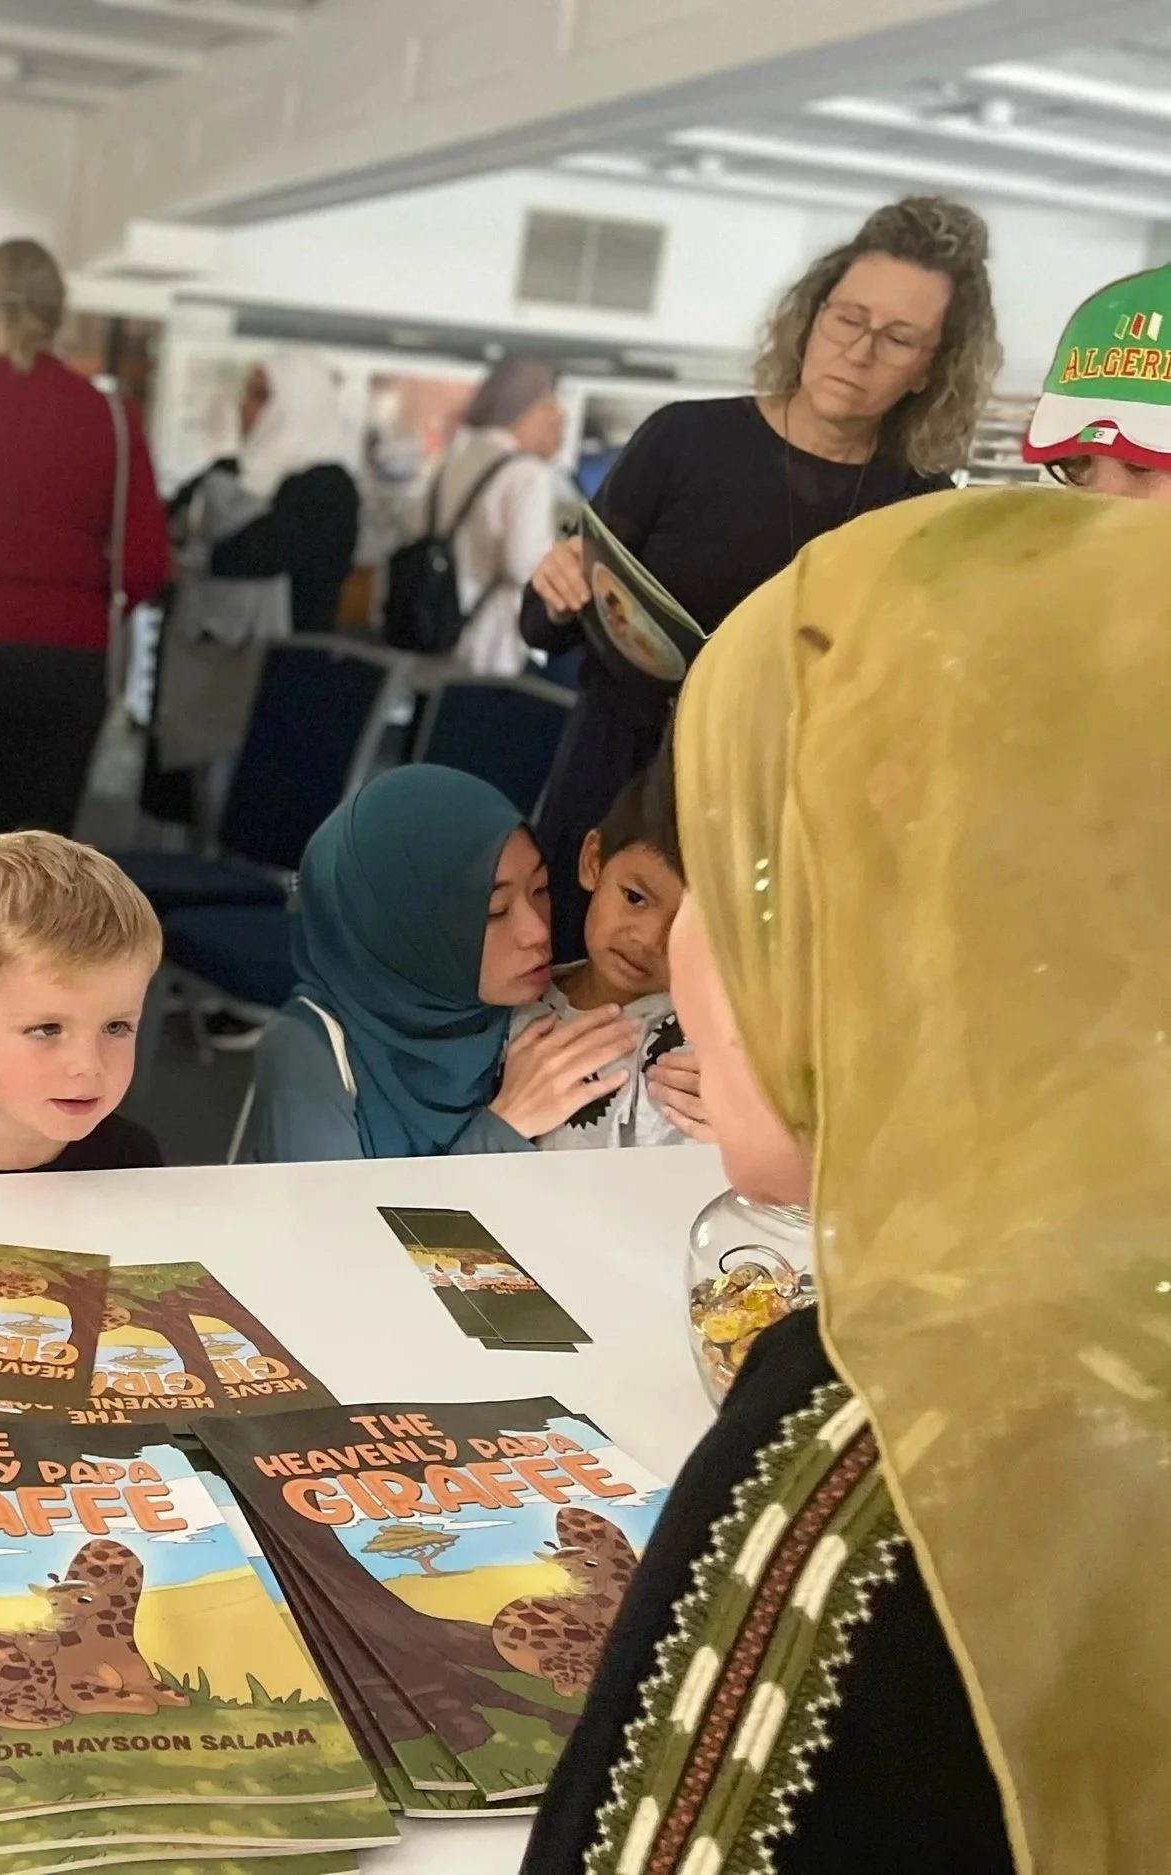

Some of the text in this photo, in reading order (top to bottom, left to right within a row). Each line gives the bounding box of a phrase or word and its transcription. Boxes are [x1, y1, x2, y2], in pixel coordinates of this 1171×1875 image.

[1059, 346, 1171, 384] ALGERI
[224, 1378, 308, 1399] HEAVE
[86, 1396, 214, 1409] HEAVENL
[68, 1410, 132, 1424] THE
[349, 1413, 445, 1440] THE
[253, 1431, 583, 1478] HEAVENLY PAPA
[39, 1460, 163, 1484] PAPA
[281, 1452, 636, 1526] GIRAFFE
[52, 1735, 191, 1756] MAYSOON
[200, 1728, 316, 1752] SALAMA
